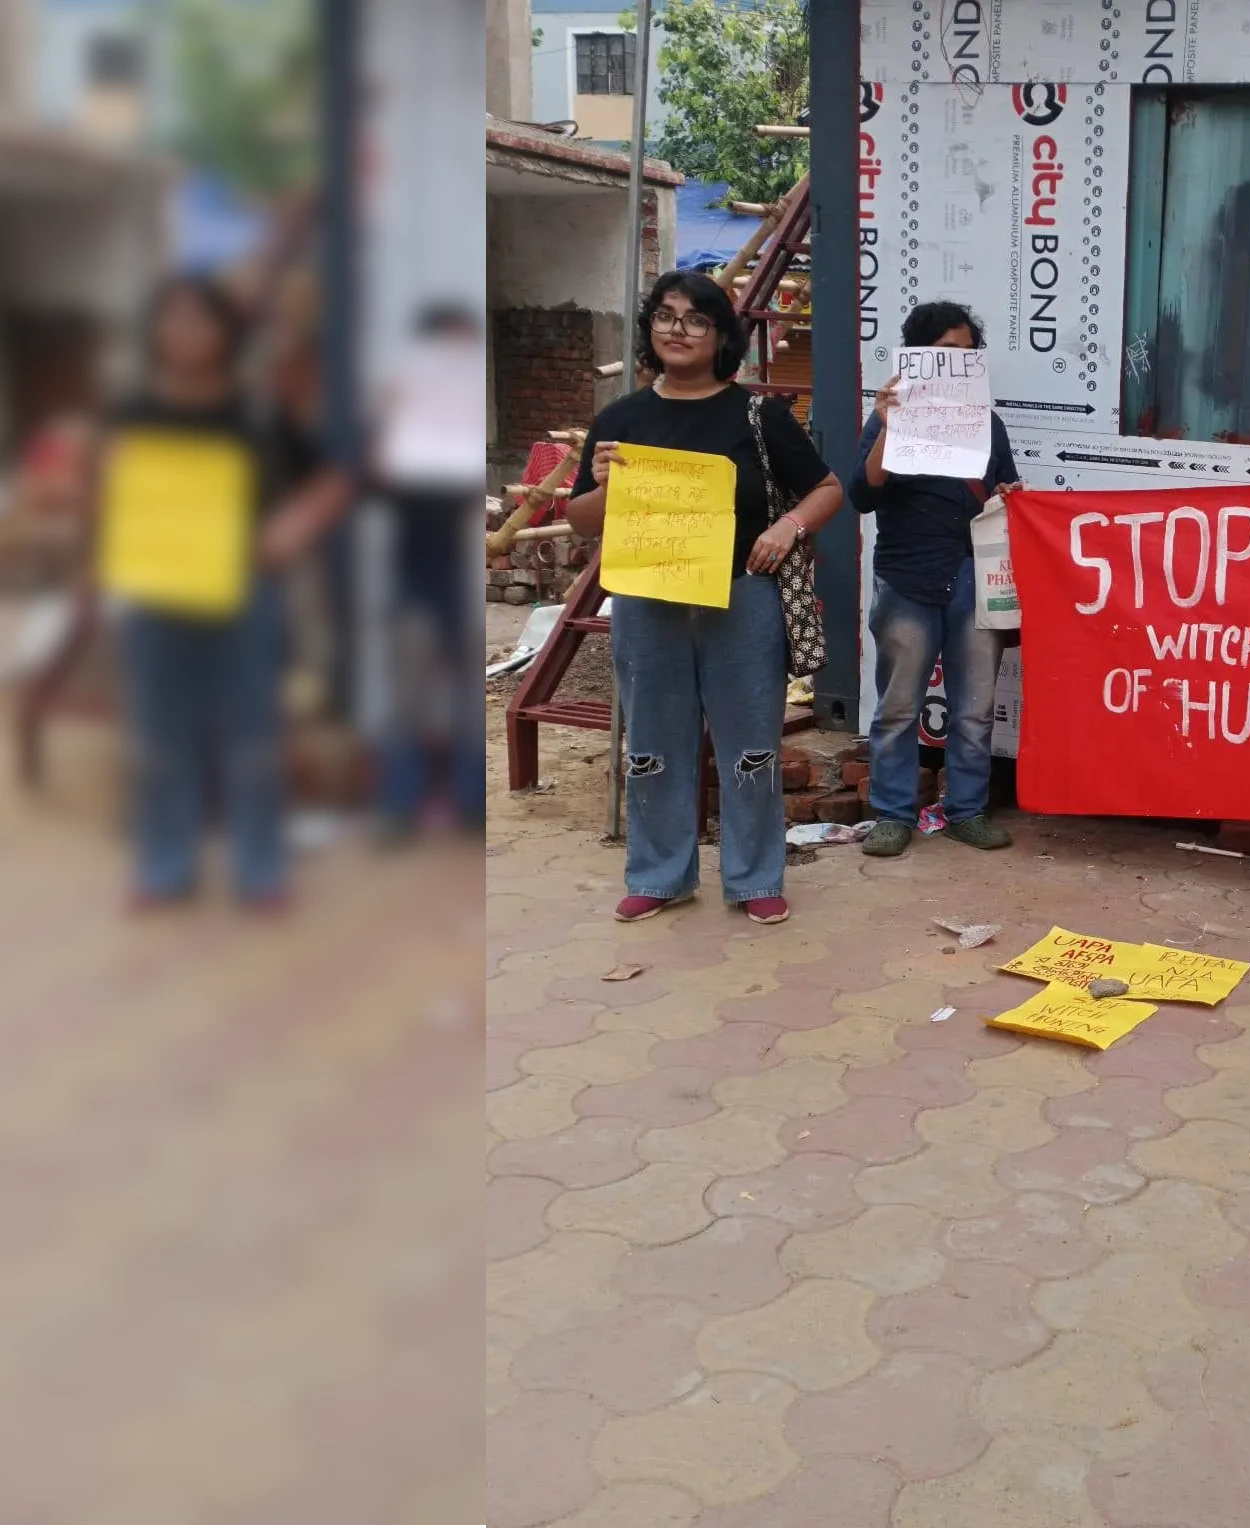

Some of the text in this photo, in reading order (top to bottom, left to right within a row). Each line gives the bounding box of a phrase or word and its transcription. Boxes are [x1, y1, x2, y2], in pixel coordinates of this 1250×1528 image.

[1024, 135, 1063, 226] city
[1008, 134, 1021, 351] PREMIUM ALUMINIUM COMPOSITE PANELS
[1029, 234, 1059, 353] BOND
[899, 351, 985, 379] PEOPLE'S
[1103, 668, 1152, 713] OF
[1054, 936, 1112, 952] UAPA
[1060, 949, 1115, 965] AFSPA
[1158, 951, 1239, 970] REPEAL
[1129, 972, 1198, 992] UAPA
